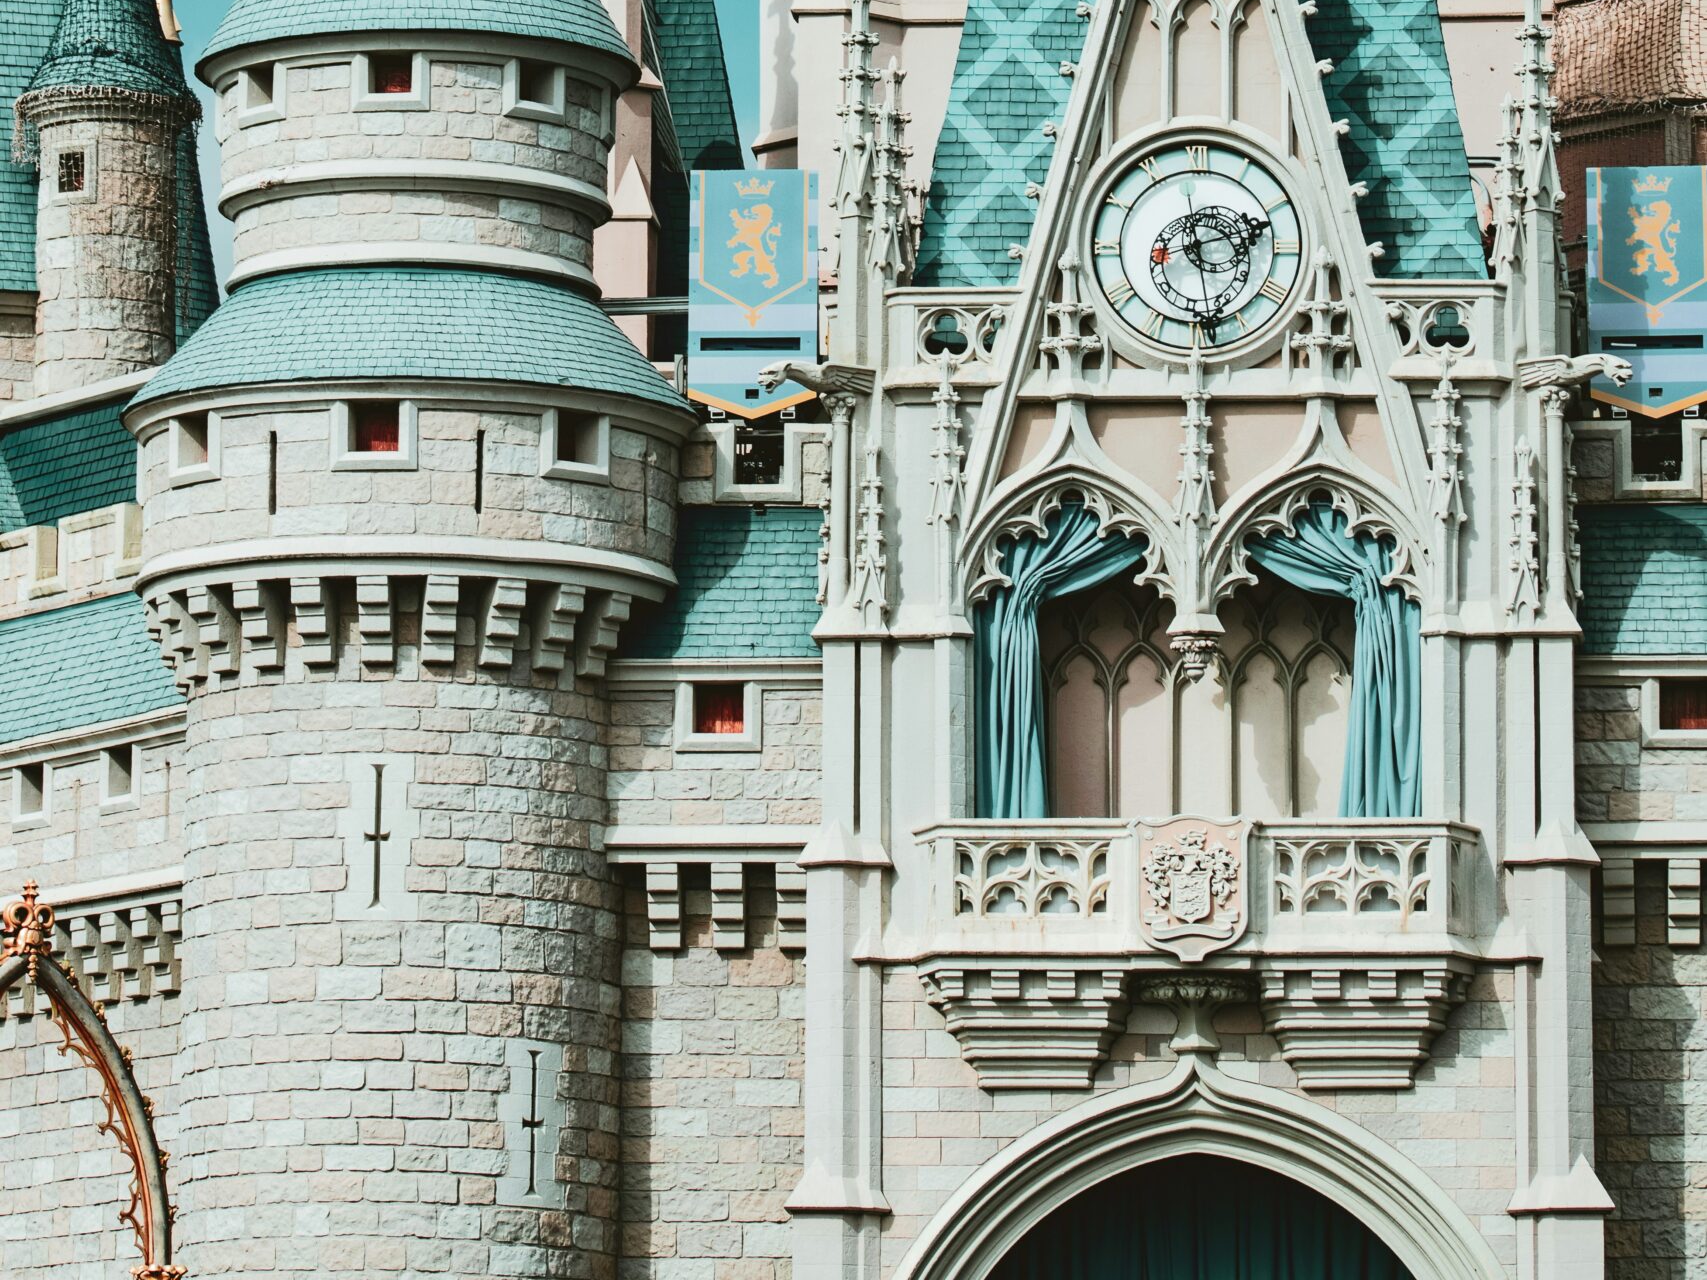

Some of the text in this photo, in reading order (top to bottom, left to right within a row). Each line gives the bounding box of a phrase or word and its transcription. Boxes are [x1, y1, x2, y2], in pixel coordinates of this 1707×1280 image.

[1138, 155, 1165, 182] XI
[1185, 145, 1208, 171] XII
[1105, 191, 1132, 213] X
[1094, 238, 1120, 255] IX
[1273, 239, 1299, 254] III
